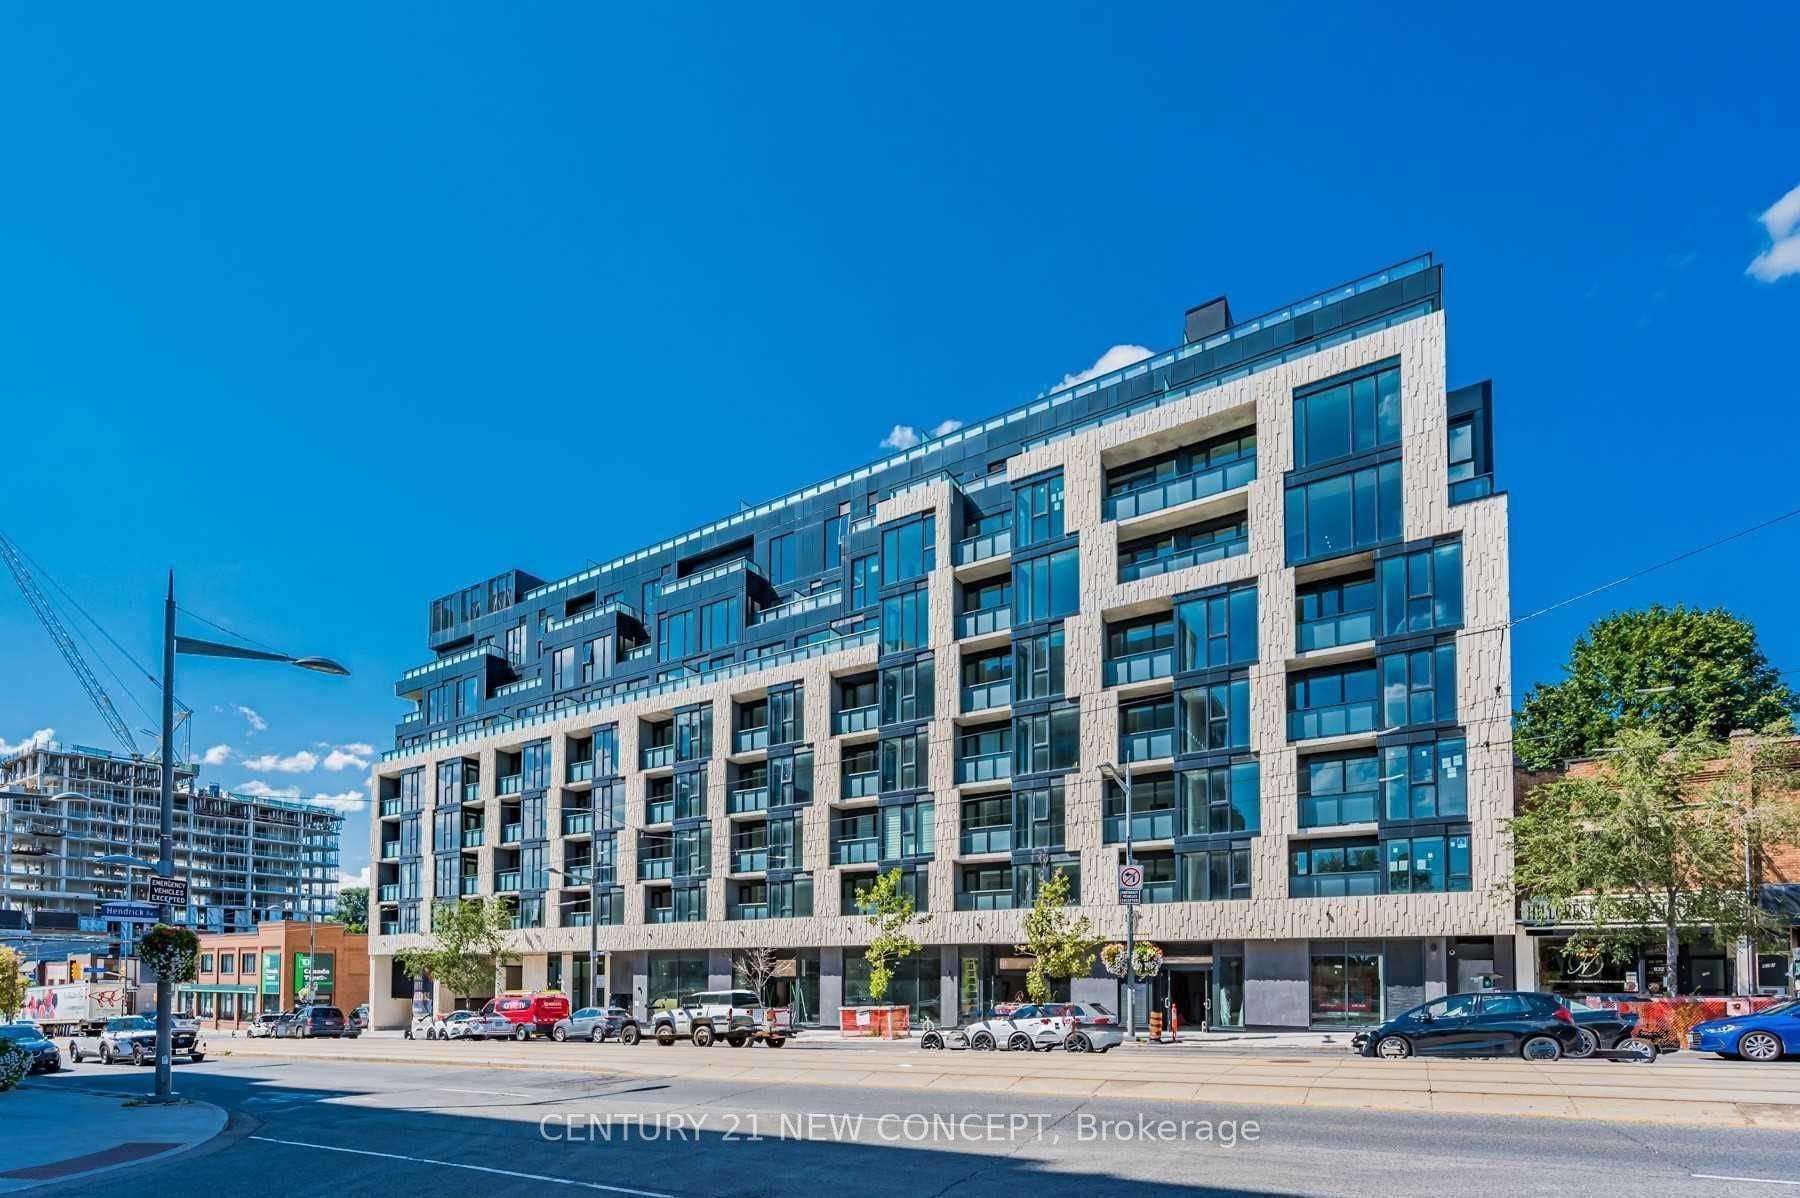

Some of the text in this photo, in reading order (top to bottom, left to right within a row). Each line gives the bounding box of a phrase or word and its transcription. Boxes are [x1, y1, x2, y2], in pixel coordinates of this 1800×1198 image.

[152, 879, 186, 888] EMERGENCY
[153, 887, 184, 896] VEHICLES
[151, 895, 186, 904] EXCEPTED
[106, 906, 144, 916] Hendrick
